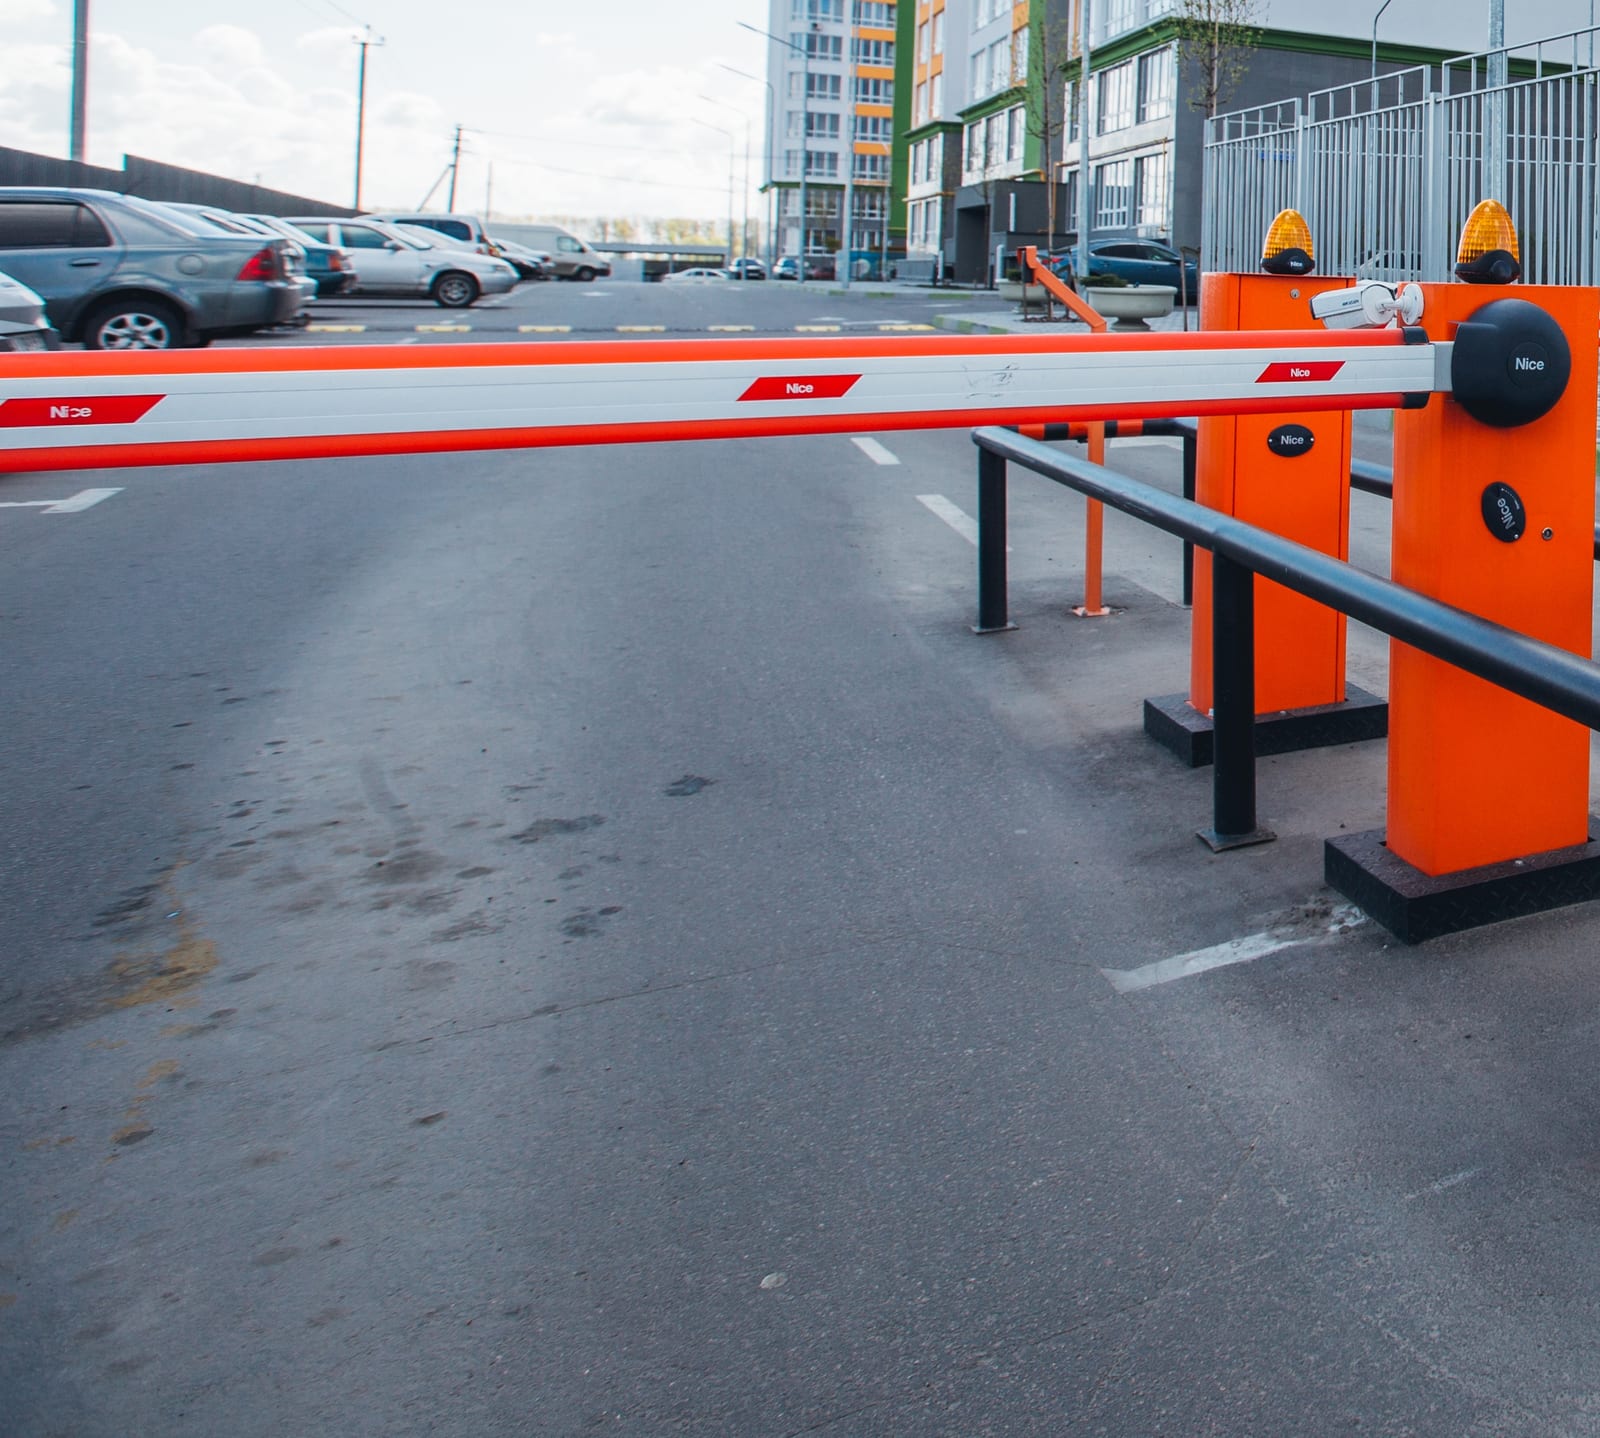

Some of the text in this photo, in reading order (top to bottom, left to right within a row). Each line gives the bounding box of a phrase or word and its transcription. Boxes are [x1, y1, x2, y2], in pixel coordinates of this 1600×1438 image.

[1515, 357, 1545, 370] Nice
[1290, 367, 1310, 377] Nice
[786, 383, 814, 394] Nice
[1280, 435, 1304, 445] Nice
[1497, 498, 1516, 530] Nice
